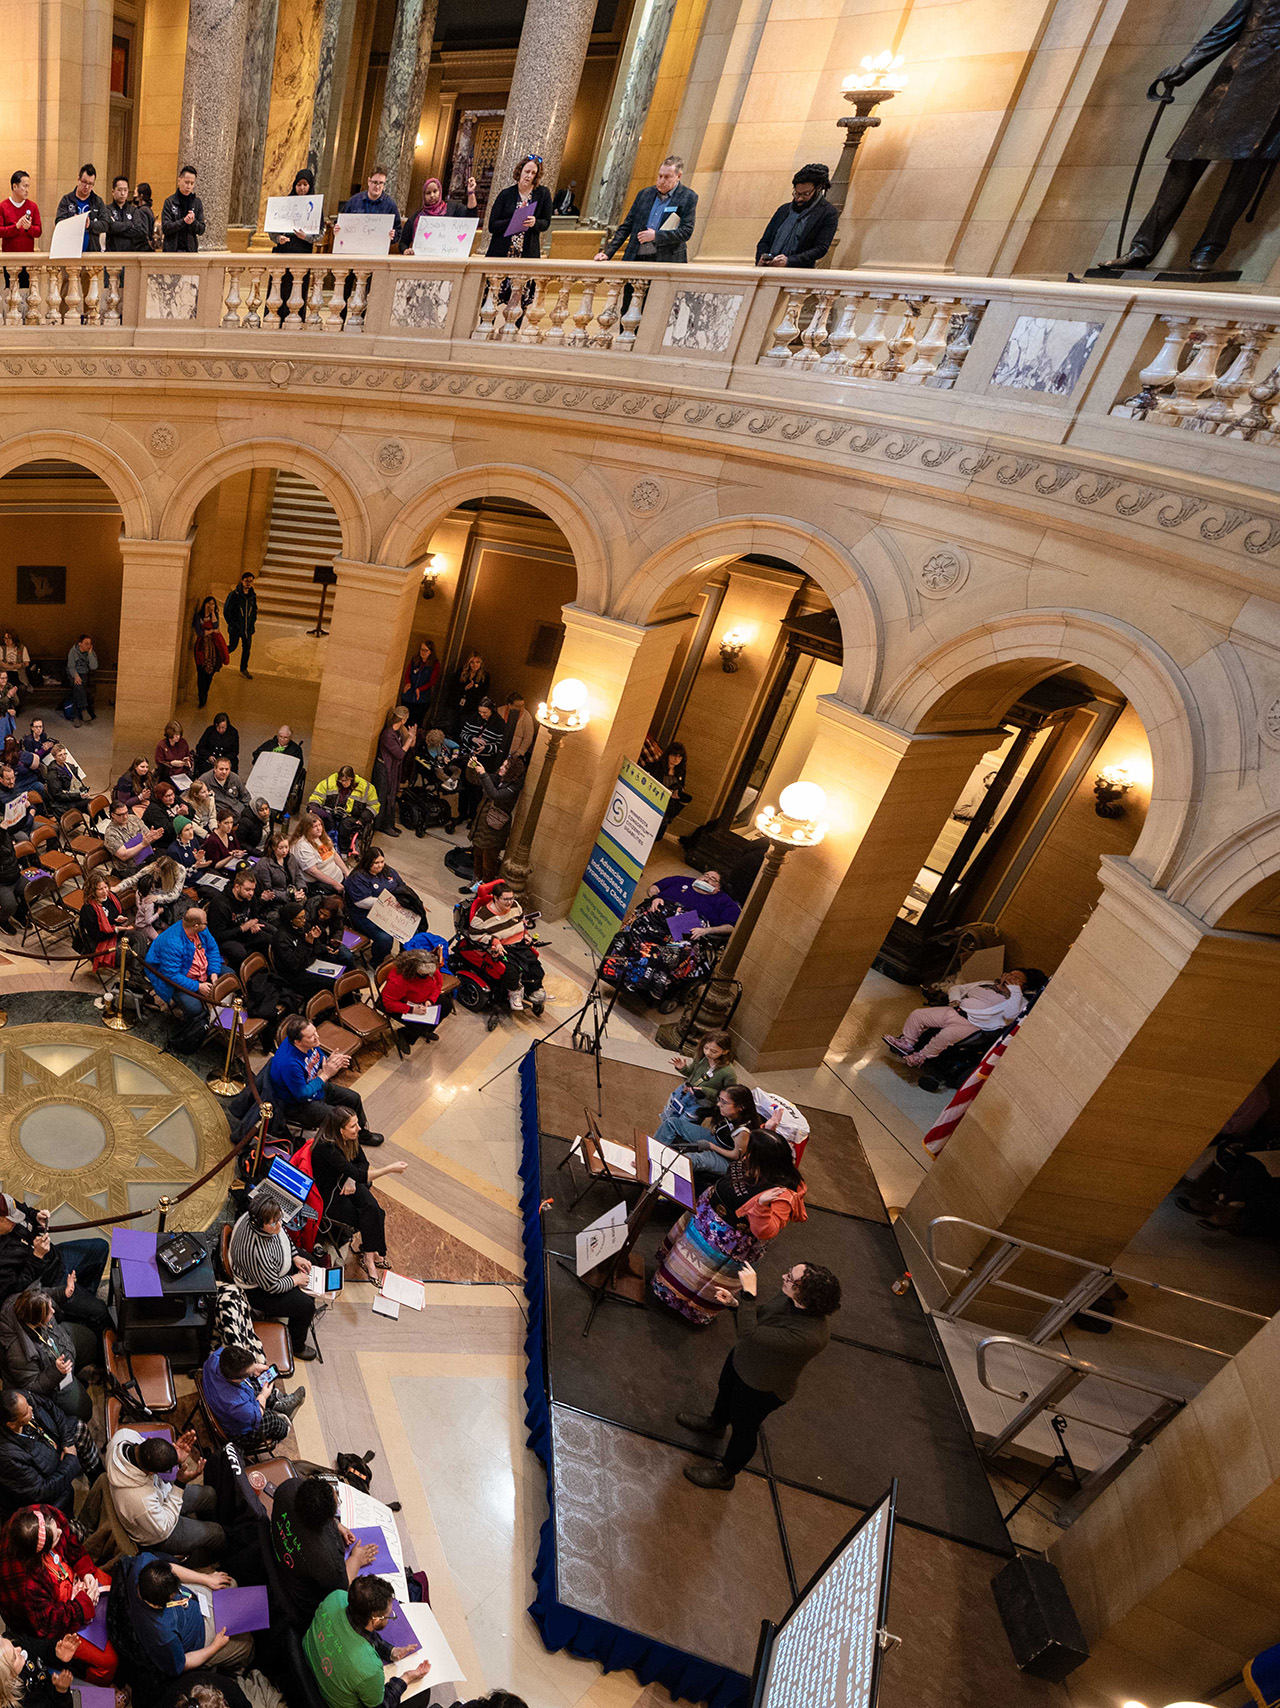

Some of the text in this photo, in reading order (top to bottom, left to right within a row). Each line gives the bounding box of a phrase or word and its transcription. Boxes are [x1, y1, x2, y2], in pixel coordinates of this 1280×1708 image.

[587, 865, 626, 909] Promoting Choice
[591, 859, 623, 894] Independence
[600, 857, 624, 885] Advancing
[874, 1510, 882, 1532] We
[856, 1531, 866, 1573] people
[863, 1522, 873, 1589] accessible
[833, 1575, 844, 1608] Let's
[841, 1557, 852, 1602] Cheers
[855, 1575, 862, 1590] of
[871, 1566, 877, 1582] to
[803, 1599, 812, 1628] This
[812, 1584, 824, 1634] support
[819, 1576, 830, 1629] services
[825, 1586, 836, 1623] home
[847, 1586, 854, 1606] be
[868, 1583, 876, 1617] fund
[810, 1633, 816, 1648] is
[843, 1608, 851, 1644] safe.
[848, 1611, 858, 1670] abilities
[855, 1590, 867, 1685] playgrounds
[771, 1639, 784, 1684] Cheers
[793, 1629, 805, 1683] ensures
[813, 1629, 822, 1667] while
[825, 1637, 835, 1680] direct
[830, 1632, 842, 1701] applause
[863, 1617, 874, 1690] inclusive
[778, 1680, 786, 1708] and
[810, 1668, 818, 1693] the
